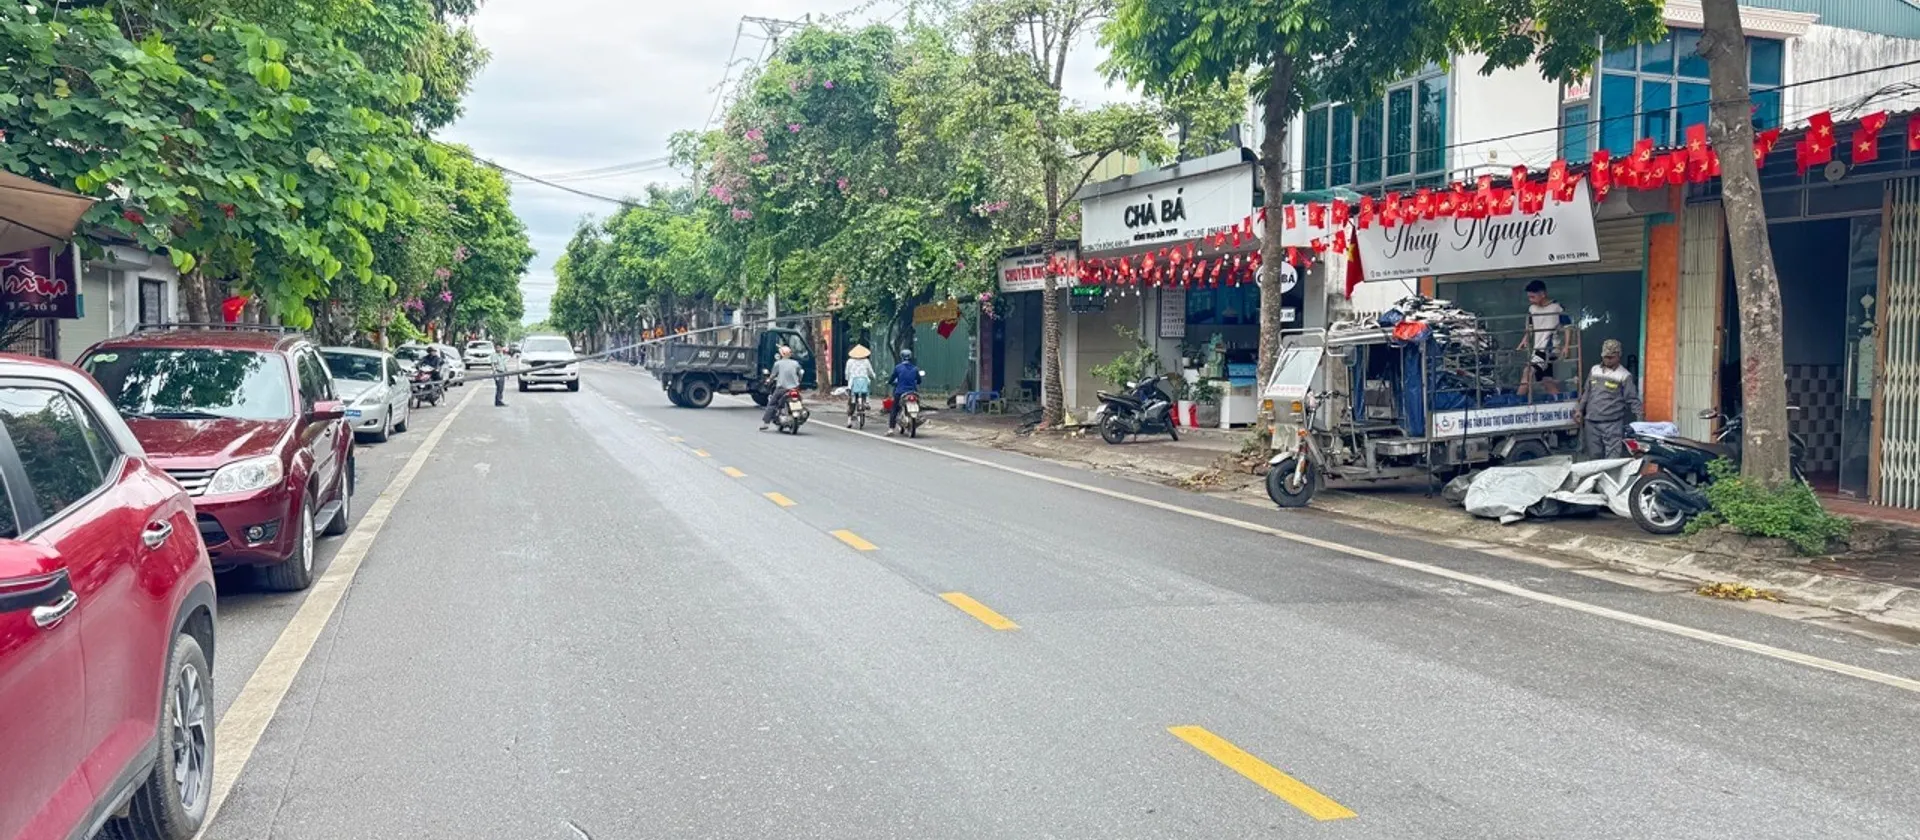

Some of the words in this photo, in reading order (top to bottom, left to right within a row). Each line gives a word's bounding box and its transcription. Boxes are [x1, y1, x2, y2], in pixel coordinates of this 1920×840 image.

[1124, 193, 1157, 229] CHÀ
[1161, 187, 1186, 223] BÁ
[1383, 224, 1440, 265] Thúy
[1458, 418, 1473, 429] TRNG
